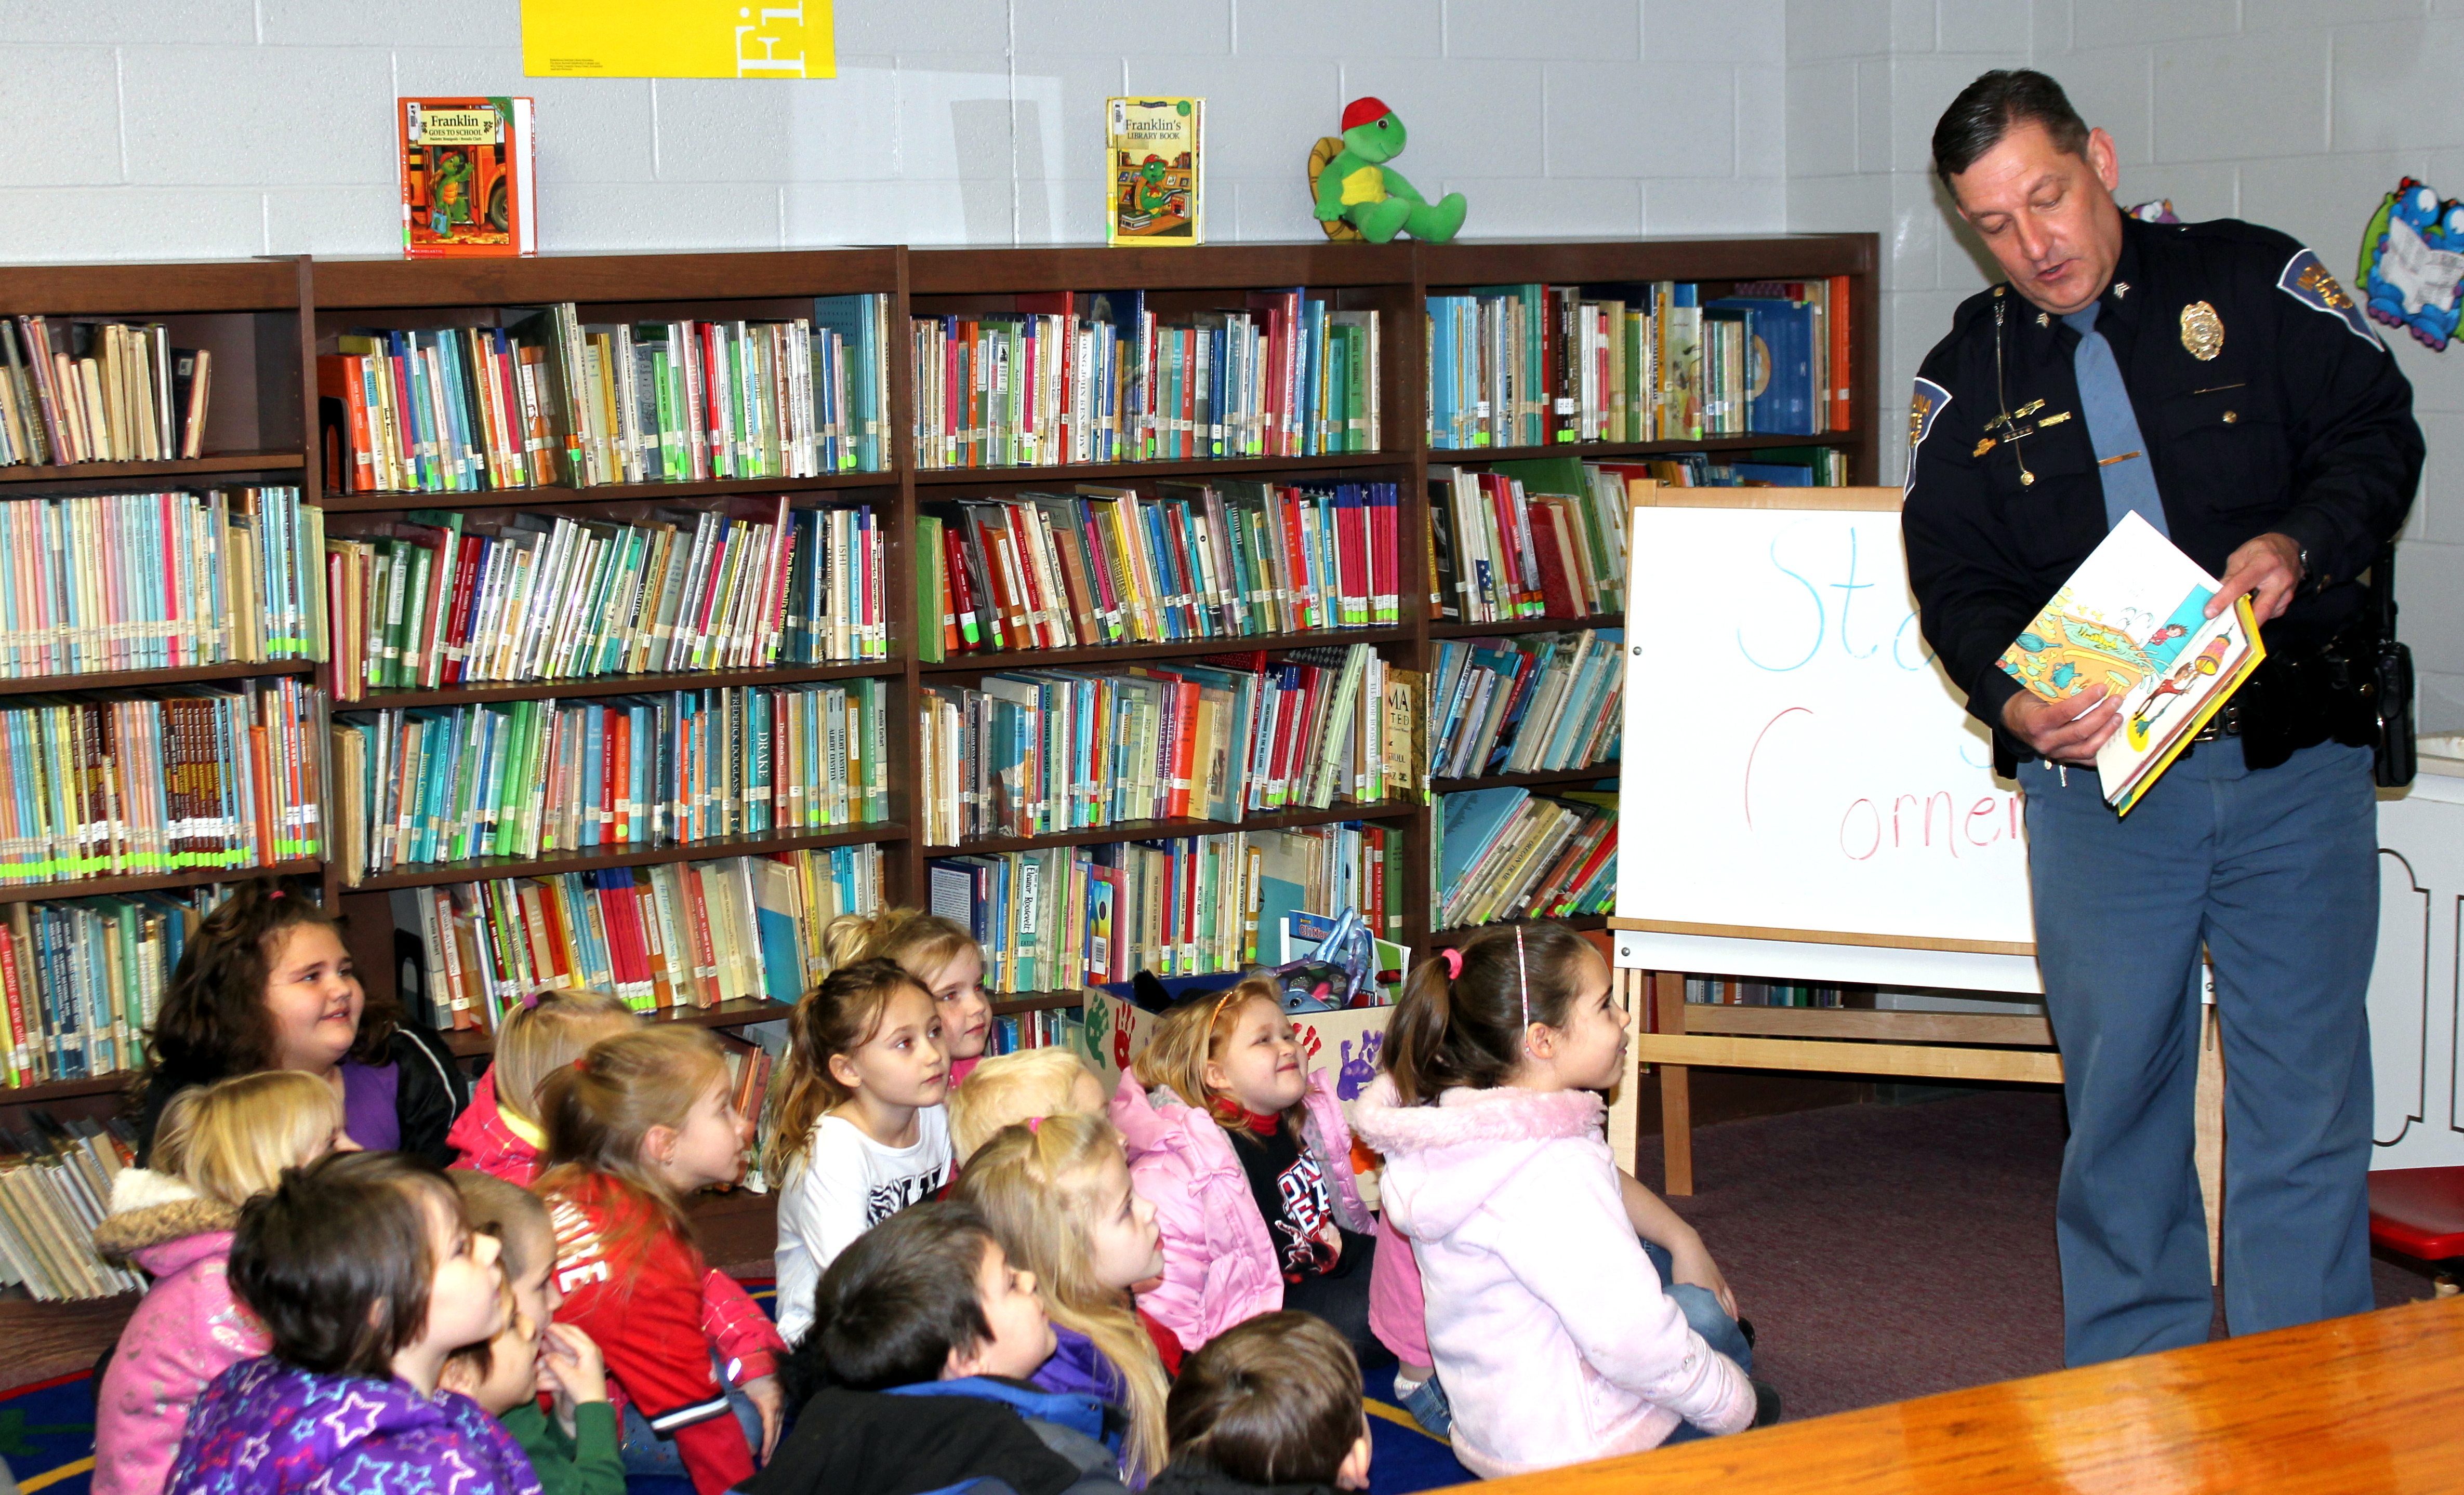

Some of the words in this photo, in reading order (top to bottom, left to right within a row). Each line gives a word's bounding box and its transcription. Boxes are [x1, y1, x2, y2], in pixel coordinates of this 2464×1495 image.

[431, 114, 479, 127] Franklin
[1126, 118, 1181, 130] Franklin's
[689, 365, 703, 448] BEETHOVN
[778, 609, 787, 636] Greates
[1391, 712, 1410, 726] TED
[758, 732, 768, 778] DRAKE
[1025, 867, 1035, 894] Eleanor
[1023, 897, 1034, 932] Roosevelt
[1300, 924, 1332, 940] Cliffor
[12, 1024, 24, 1044] CHIN
